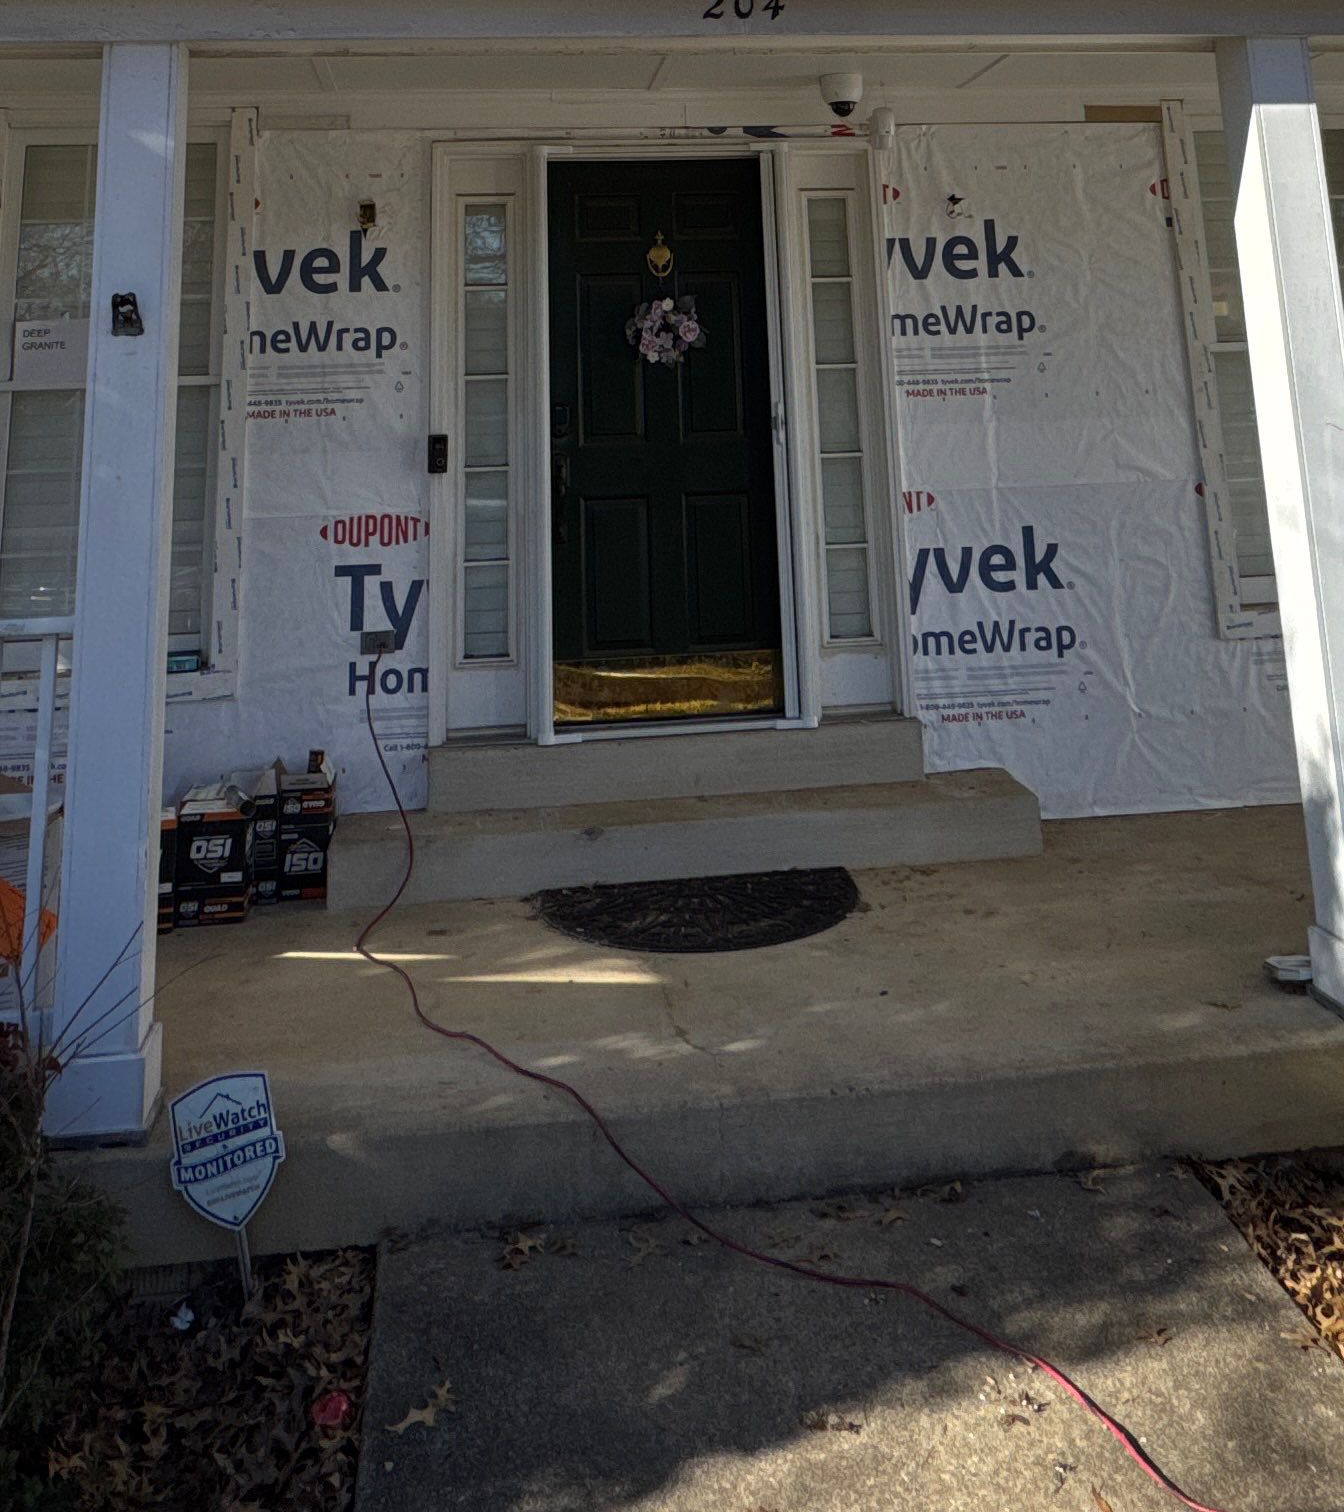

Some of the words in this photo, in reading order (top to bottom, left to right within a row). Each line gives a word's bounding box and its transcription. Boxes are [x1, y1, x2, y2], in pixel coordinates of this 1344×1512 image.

[253, 230, 390, 295] vek
[22, 328, 51, 338] DEEP
[22, 340, 67, 351] GRANITE
[333, 514, 421, 548] DUPONT
[190, 837, 233, 859] OSI
[178, 1099, 268, 1141] LiveWatch
[180, 1139, 278, 1183] MONITORED
